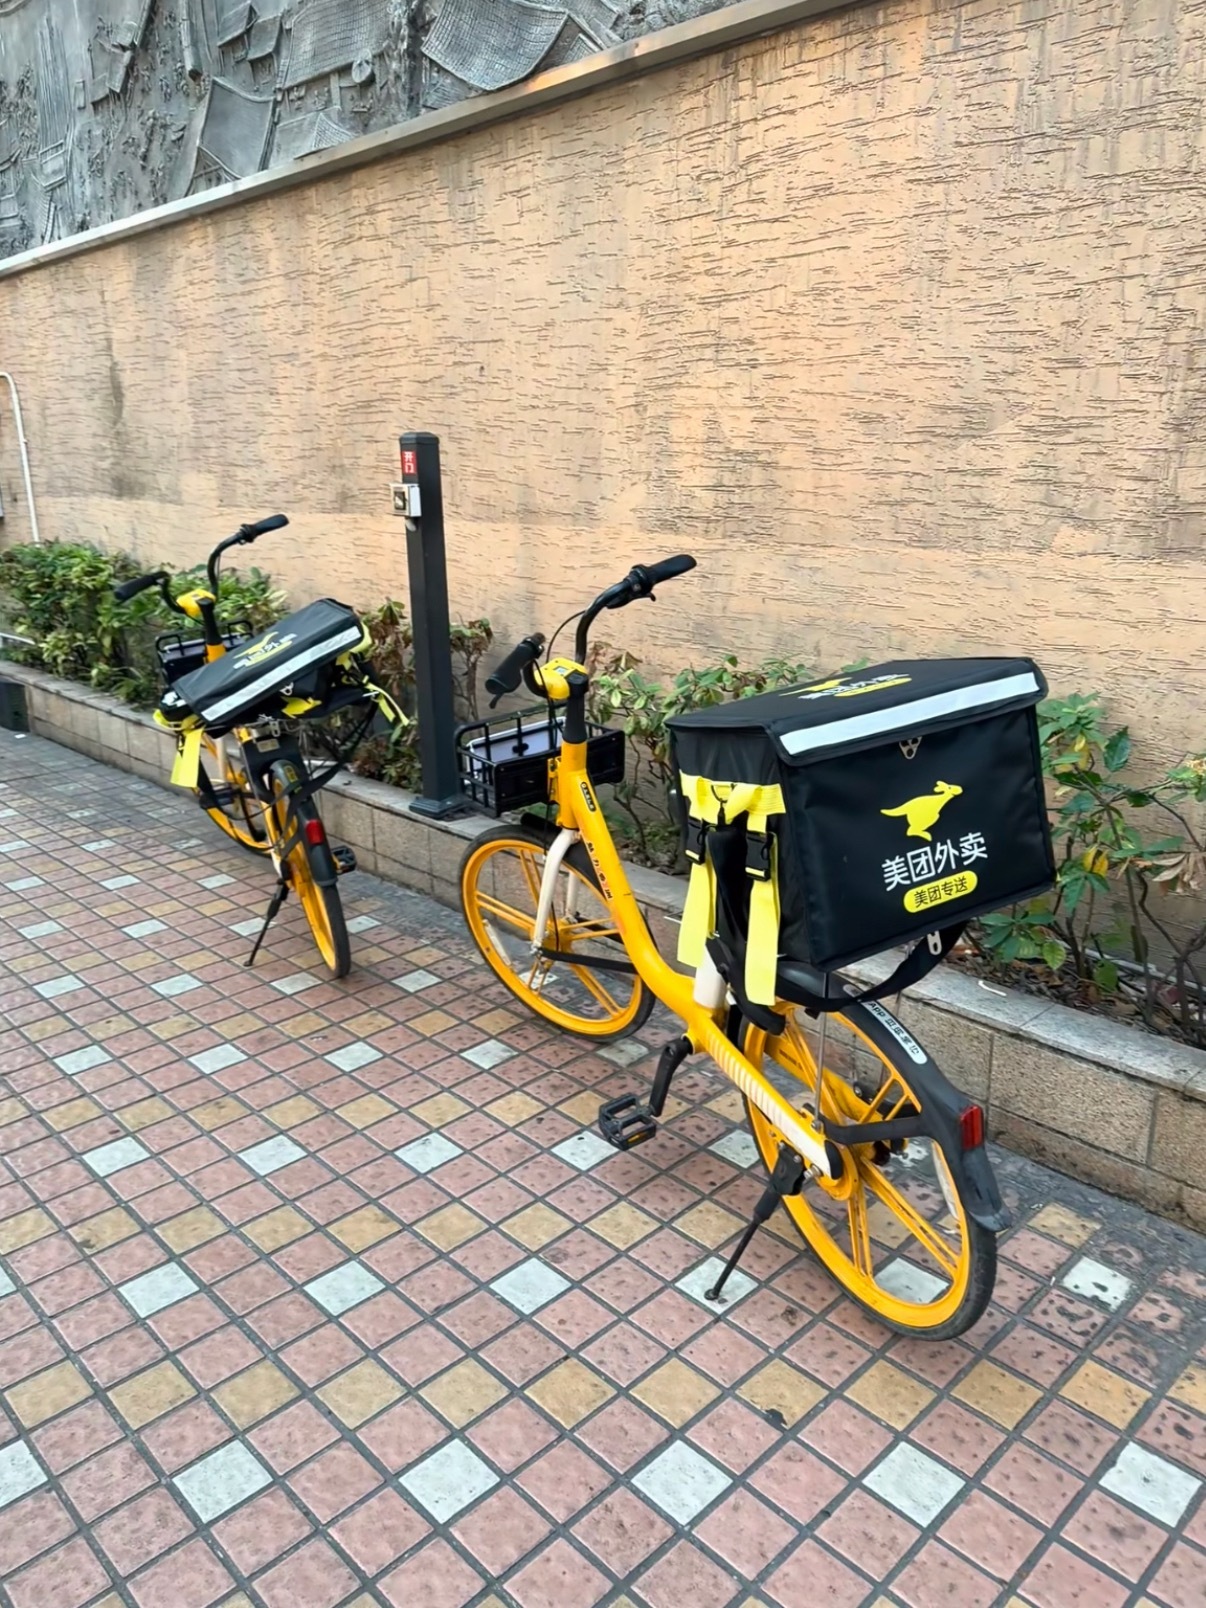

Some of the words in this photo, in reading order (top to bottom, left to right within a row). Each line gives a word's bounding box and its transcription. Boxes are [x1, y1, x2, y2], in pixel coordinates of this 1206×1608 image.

[881, 832, 988, 892] 美团外卖
[914, 875, 968, 908] 美团专送
